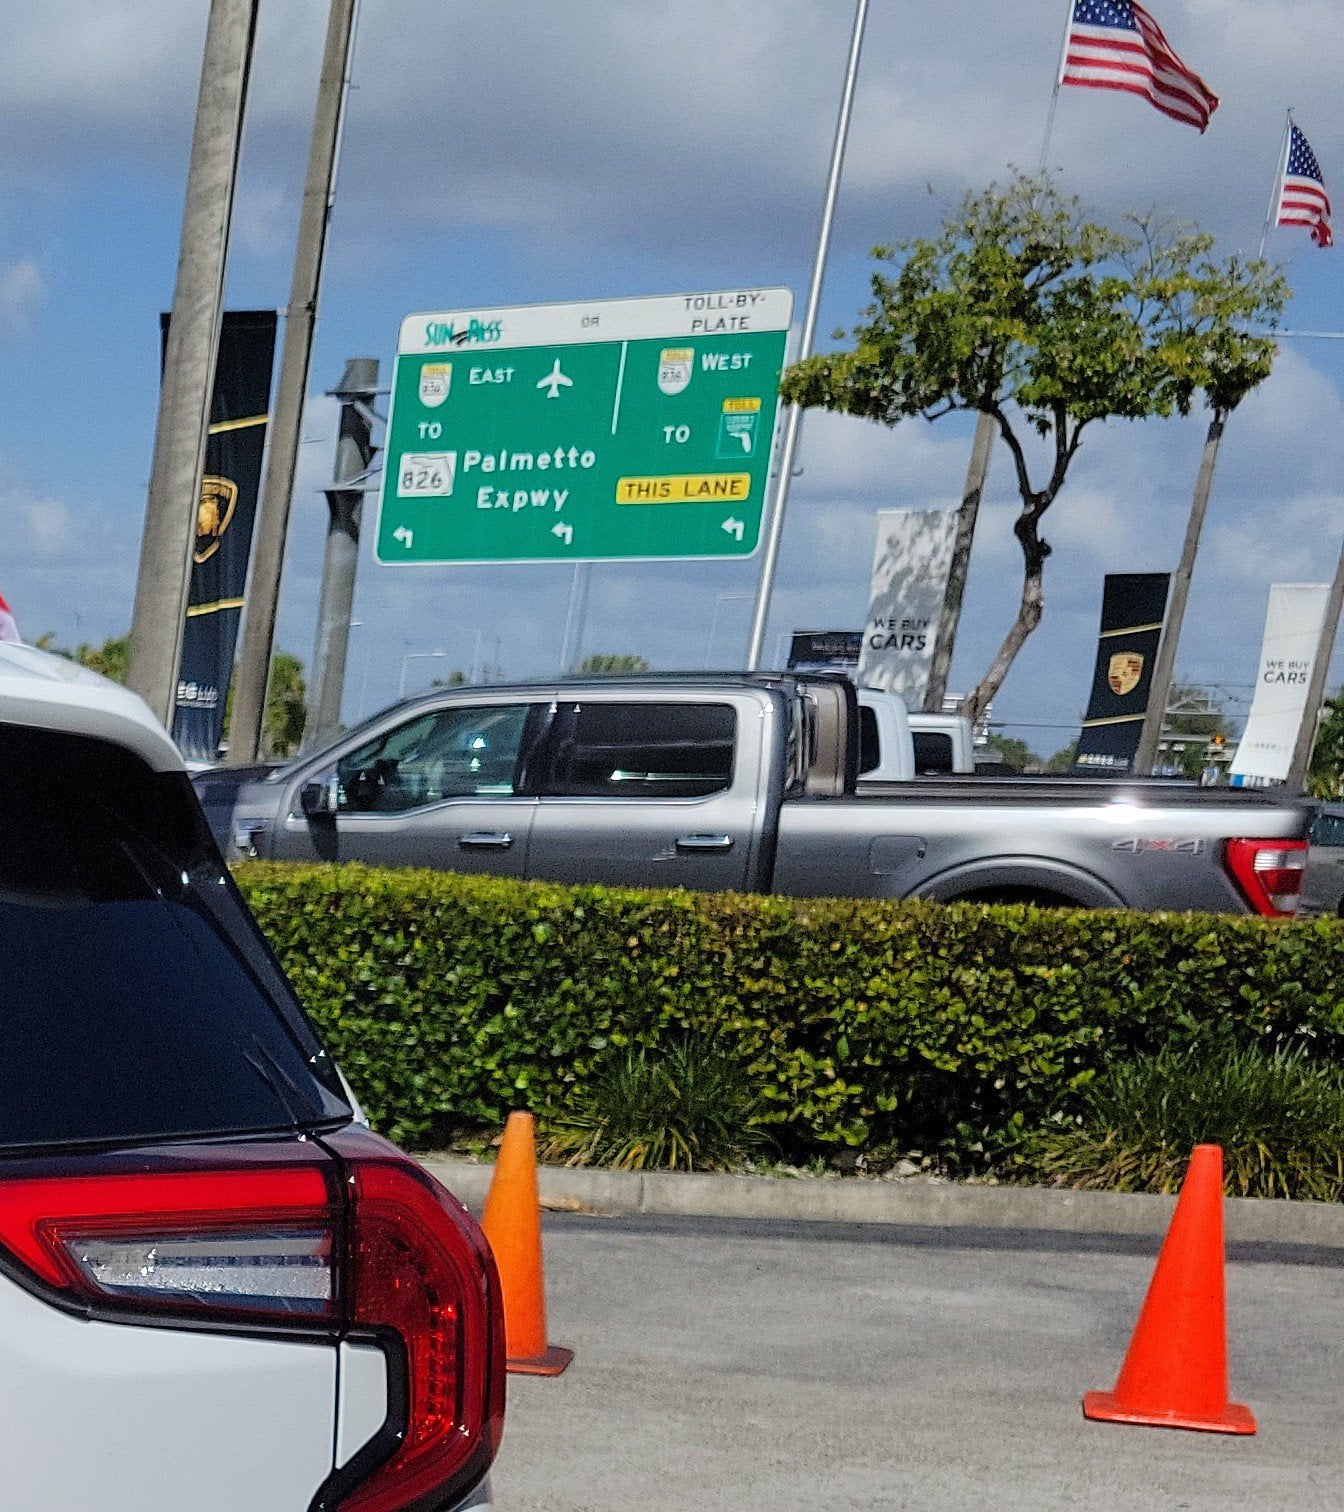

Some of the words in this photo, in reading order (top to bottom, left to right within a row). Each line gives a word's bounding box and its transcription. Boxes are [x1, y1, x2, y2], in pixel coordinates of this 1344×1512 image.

[692, 316, 751, 333] PLATE
[701, 353, 753, 371] WEST
[469, 366, 516, 385] EAST
[418, 421, 442, 439] TO
[663, 424, 691, 444] TO
[463, 446, 597, 473] Palmetto
[402, 470, 443, 490] 826
[625, 481, 673, 499] THIS
[683, 479, 742, 497] LANE
[476, 485, 570, 513] Expwy
[874, 617, 896, 631] WE
[870, 633, 927, 651] CARS
[1266, 659, 1284, 669] WE
[1288, 660, 1309, 670] BUY
[1263, 671, 1308, 685] CARS
